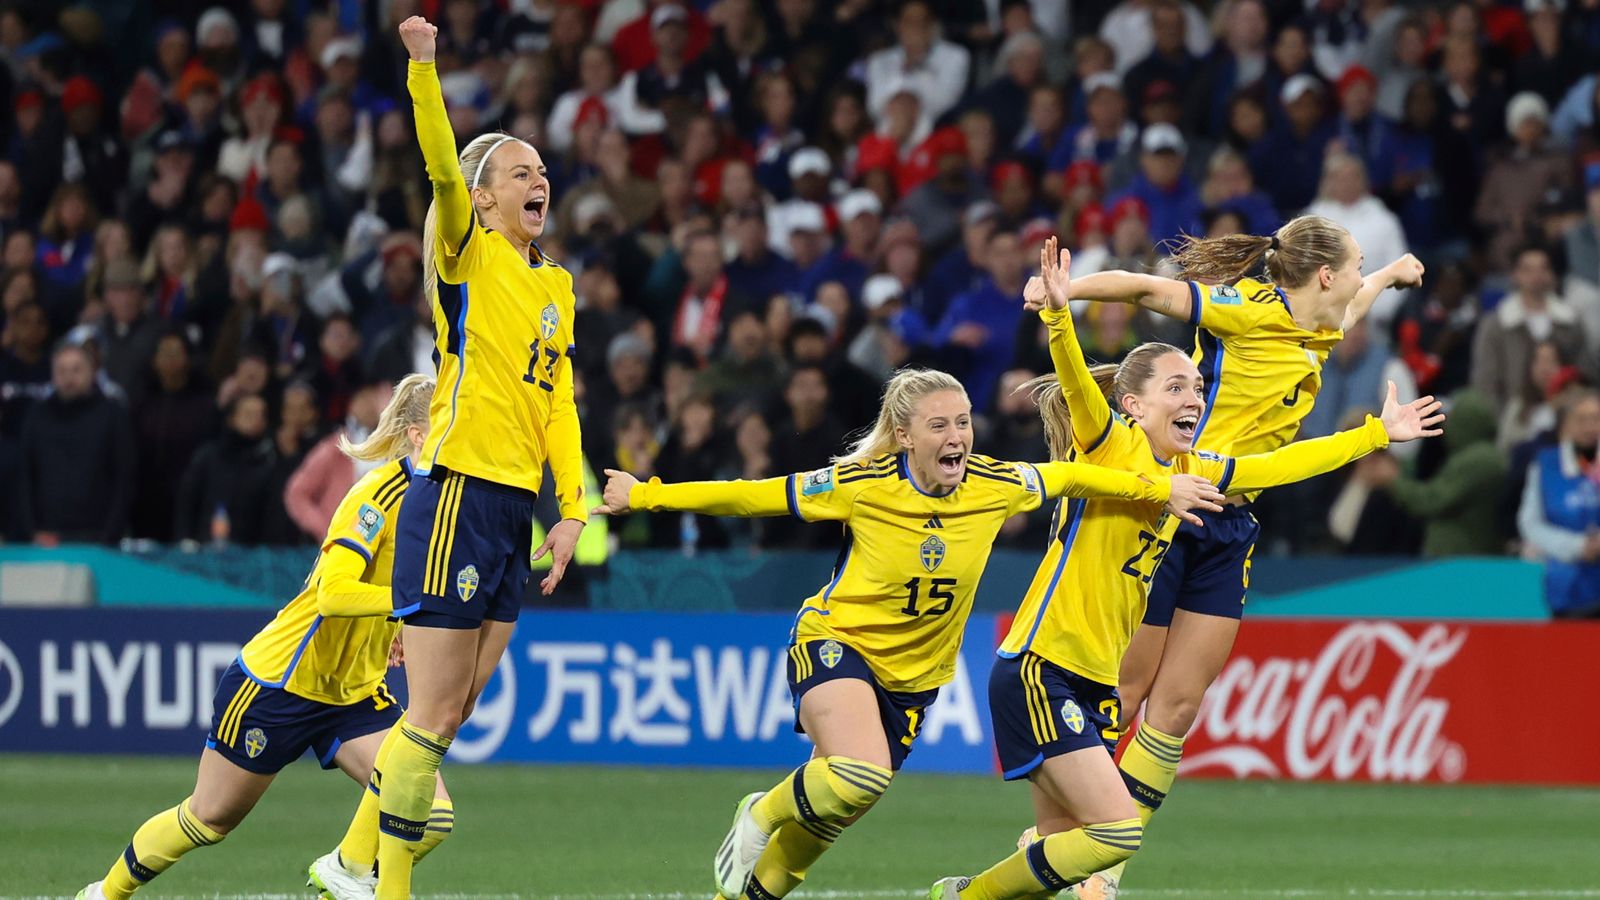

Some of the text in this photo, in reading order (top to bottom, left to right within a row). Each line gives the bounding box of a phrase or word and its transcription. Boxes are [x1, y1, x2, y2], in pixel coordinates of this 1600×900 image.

[522, 337, 560, 393] 13
[901, 576, 958, 617] 15
[527, 637, 692, 746] 万达
